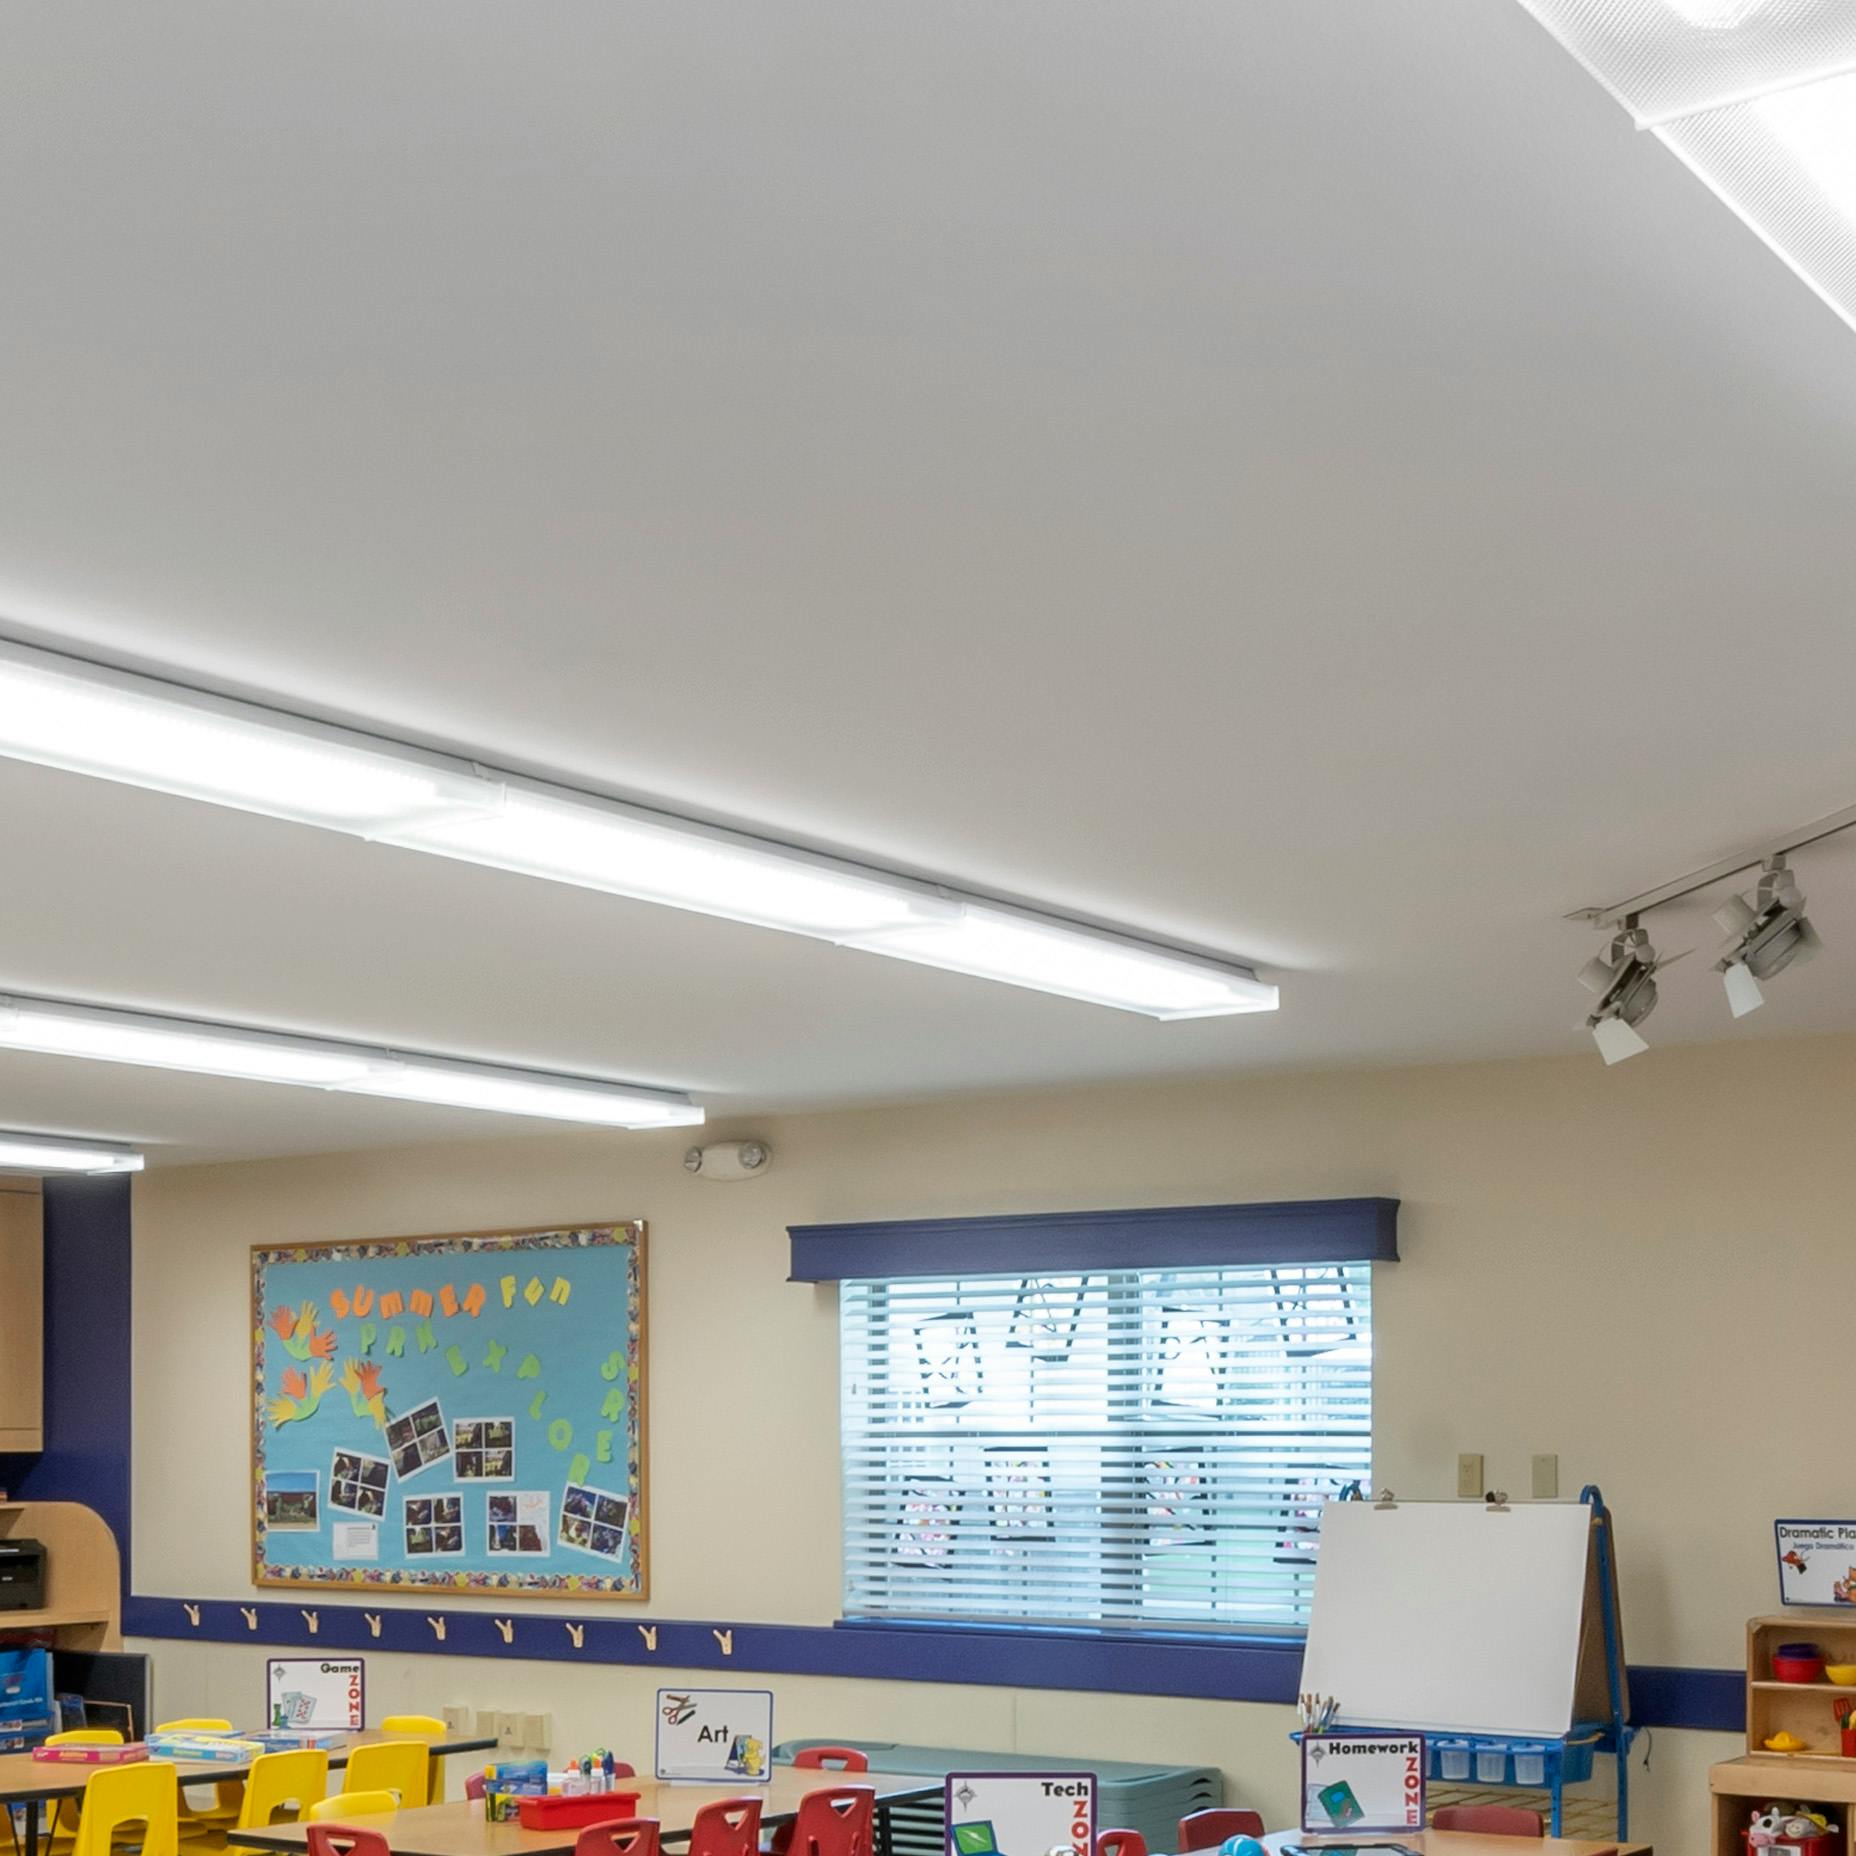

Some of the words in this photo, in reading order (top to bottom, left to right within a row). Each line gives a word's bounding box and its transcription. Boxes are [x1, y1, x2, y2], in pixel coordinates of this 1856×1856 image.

[1779, 1526, 1835, 1539] Dramatic
[320, 1663, 360, 1674] Game
[348, 1675, 361, 1727] ZONE
[697, 1725, 729, 1743] Art
[1328, 1741, 1419, 1755] Homework
[1041, 1781, 1089, 1797] Tech
[1404, 1757, 1420, 1825] ZONE
